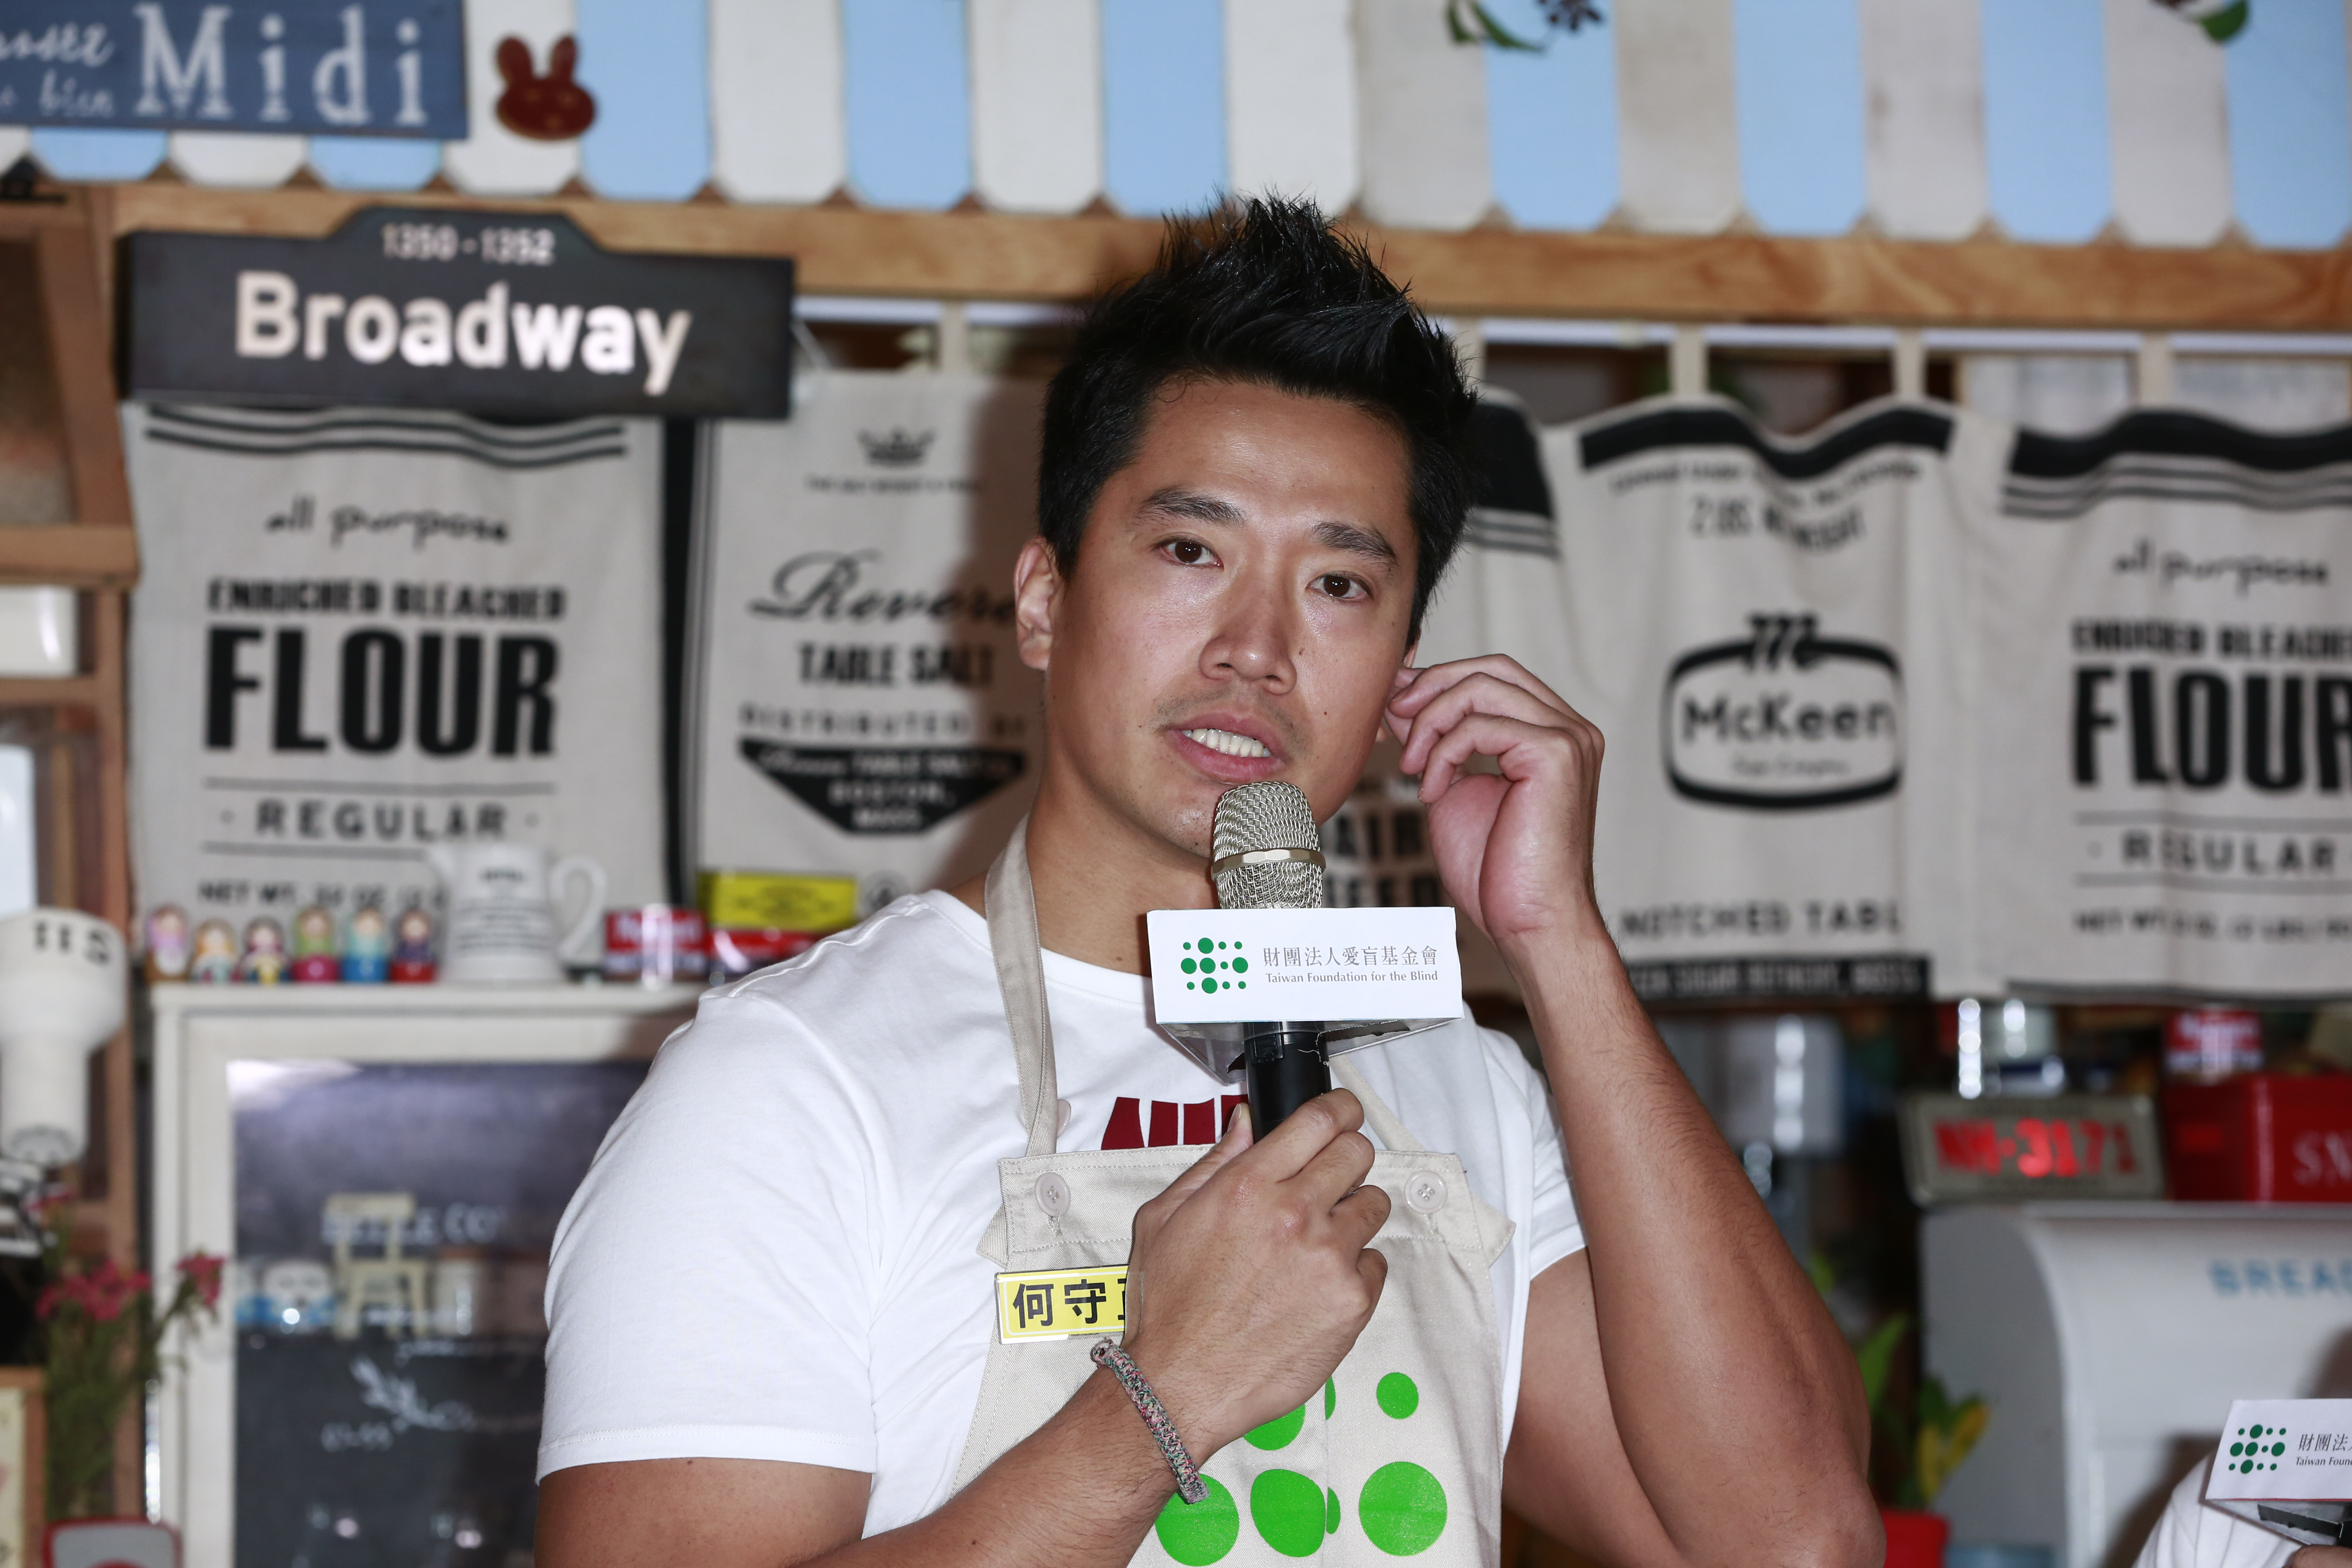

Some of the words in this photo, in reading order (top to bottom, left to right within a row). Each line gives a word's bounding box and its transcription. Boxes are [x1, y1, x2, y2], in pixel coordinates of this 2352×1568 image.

[134, 2, 428, 126] Midi
[236, 271, 692, 394] Broadway
[330, 505, 510, 549] purpose
[208, 579, 381, 614] ENRICHED
[394, 582, 566, 621] BLEACHED
[798, 641, 894, 687] TABLE
[908, 644, 993, 690] SALT
[205, 625, 558, 758] FLOUR
[256, 800, 508, 840] REGULAR
[1263, 945, 1437, 967] 財團法人愛盲基金會
[1266, 973, 1304, 983] Taiwan
[1308, 971, 1368, 982] Foundation
[1371, 971, 1386, 982] for
[1389, 971, 1407, 981] the
[1410, 970, 1438, 981] Blind
[2296, 1456, 2325, 1466] Taiwan
[2329, 1457, 2352, 1466] Foun
